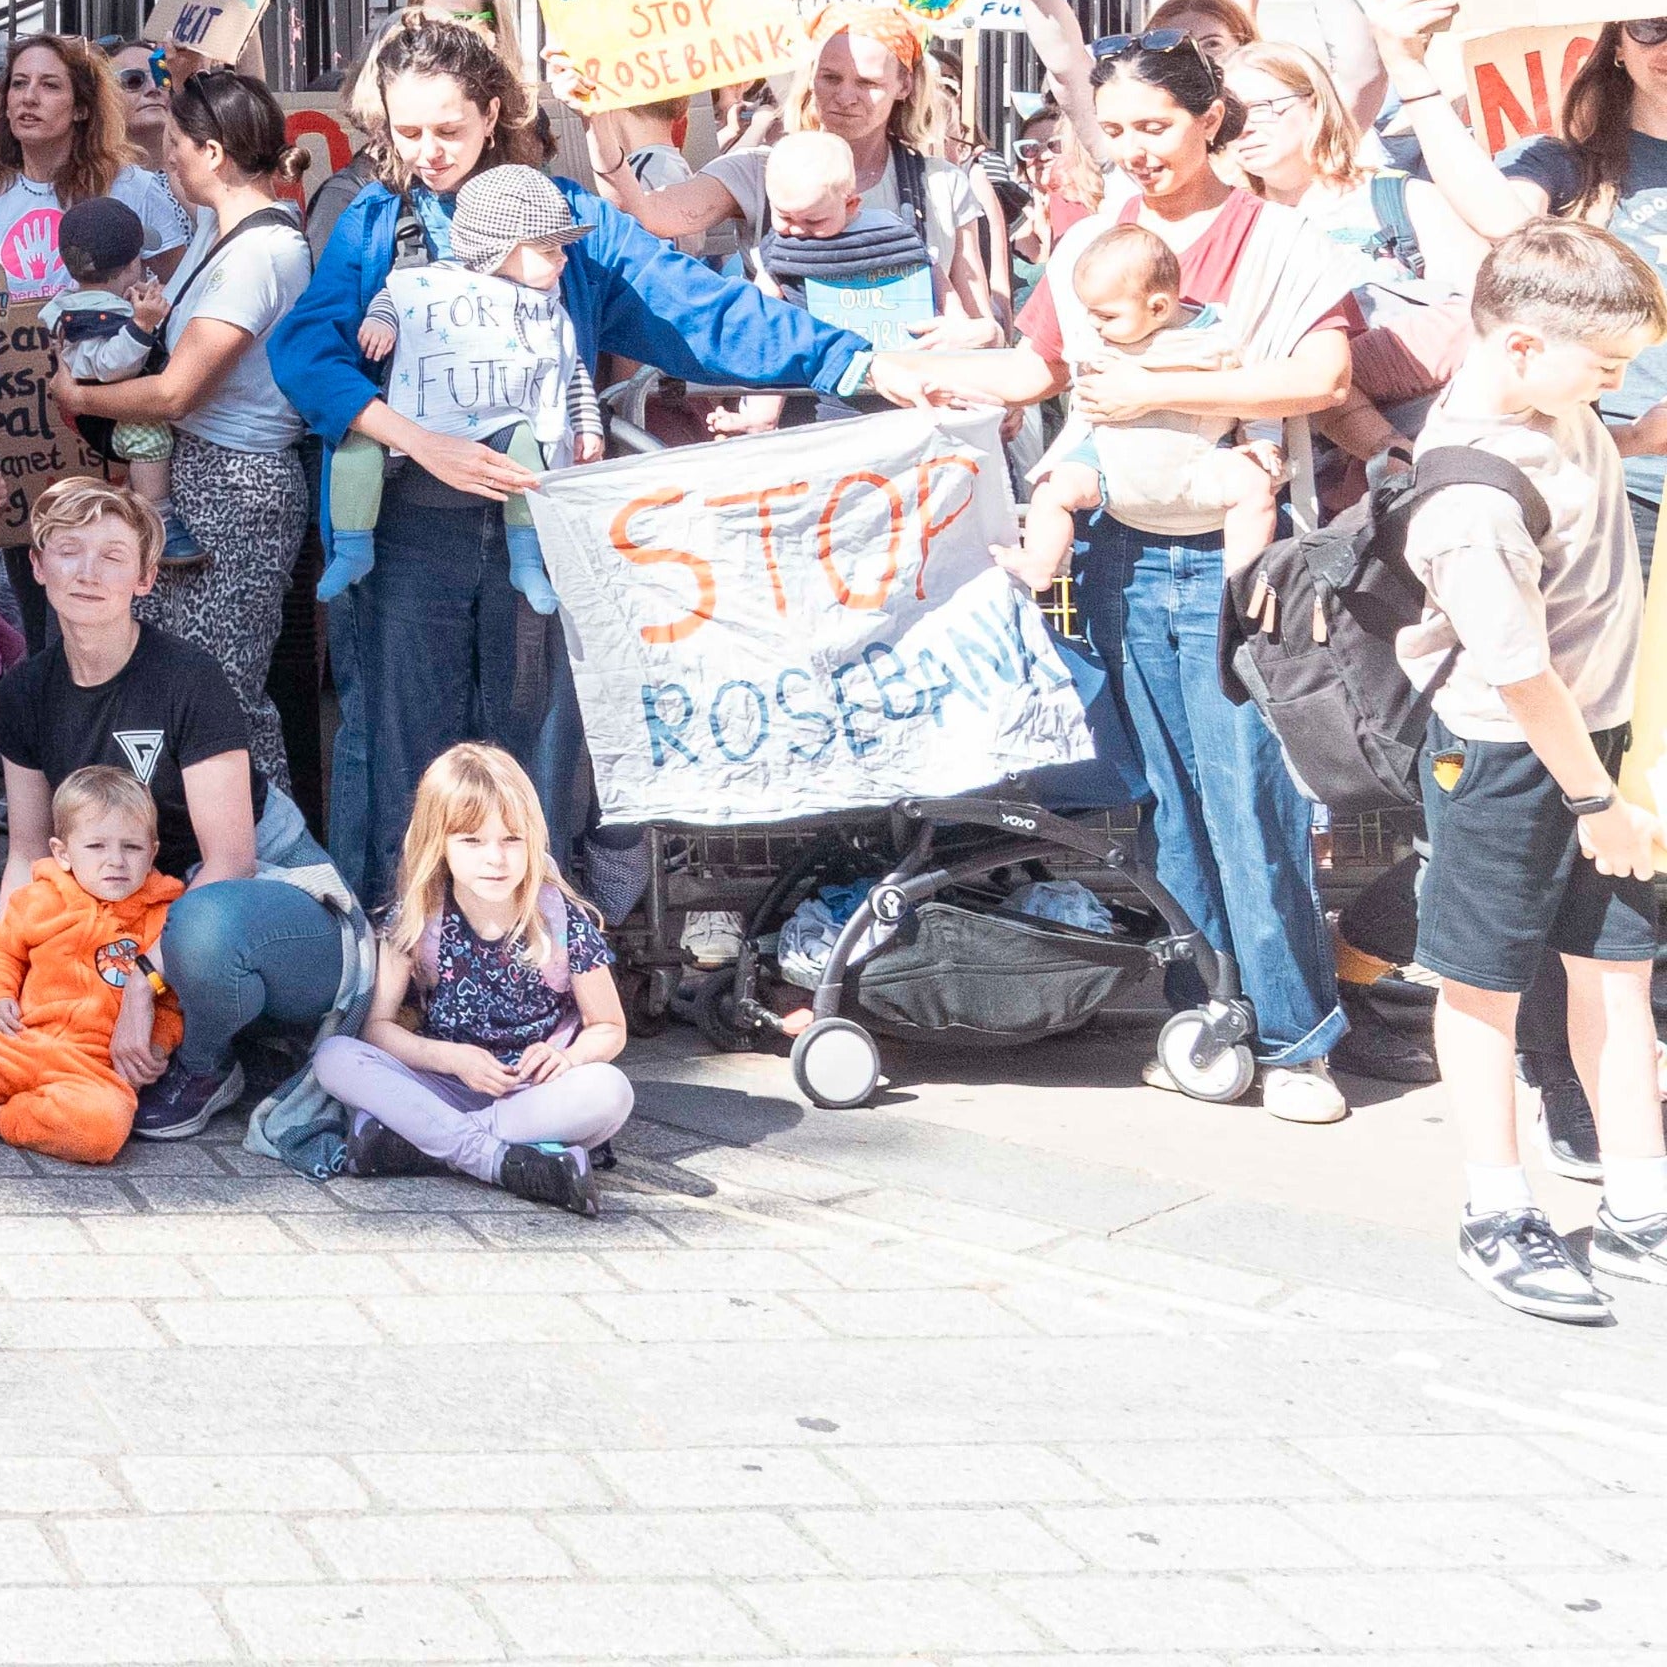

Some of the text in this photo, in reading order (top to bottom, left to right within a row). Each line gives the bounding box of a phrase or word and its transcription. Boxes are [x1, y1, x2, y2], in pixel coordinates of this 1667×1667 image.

[172, 1, 224, 45] HEAT
[581, 22, 793, 102] ROSEBANK
[424, 294, 500, 334] FOR
[838, 287, 900, 312] OUR
[608, 454, 981, 645] STOP
[640, 598, 1073, 768] ROSEBANK
[1001, 813, 1037, 831] YOYO
